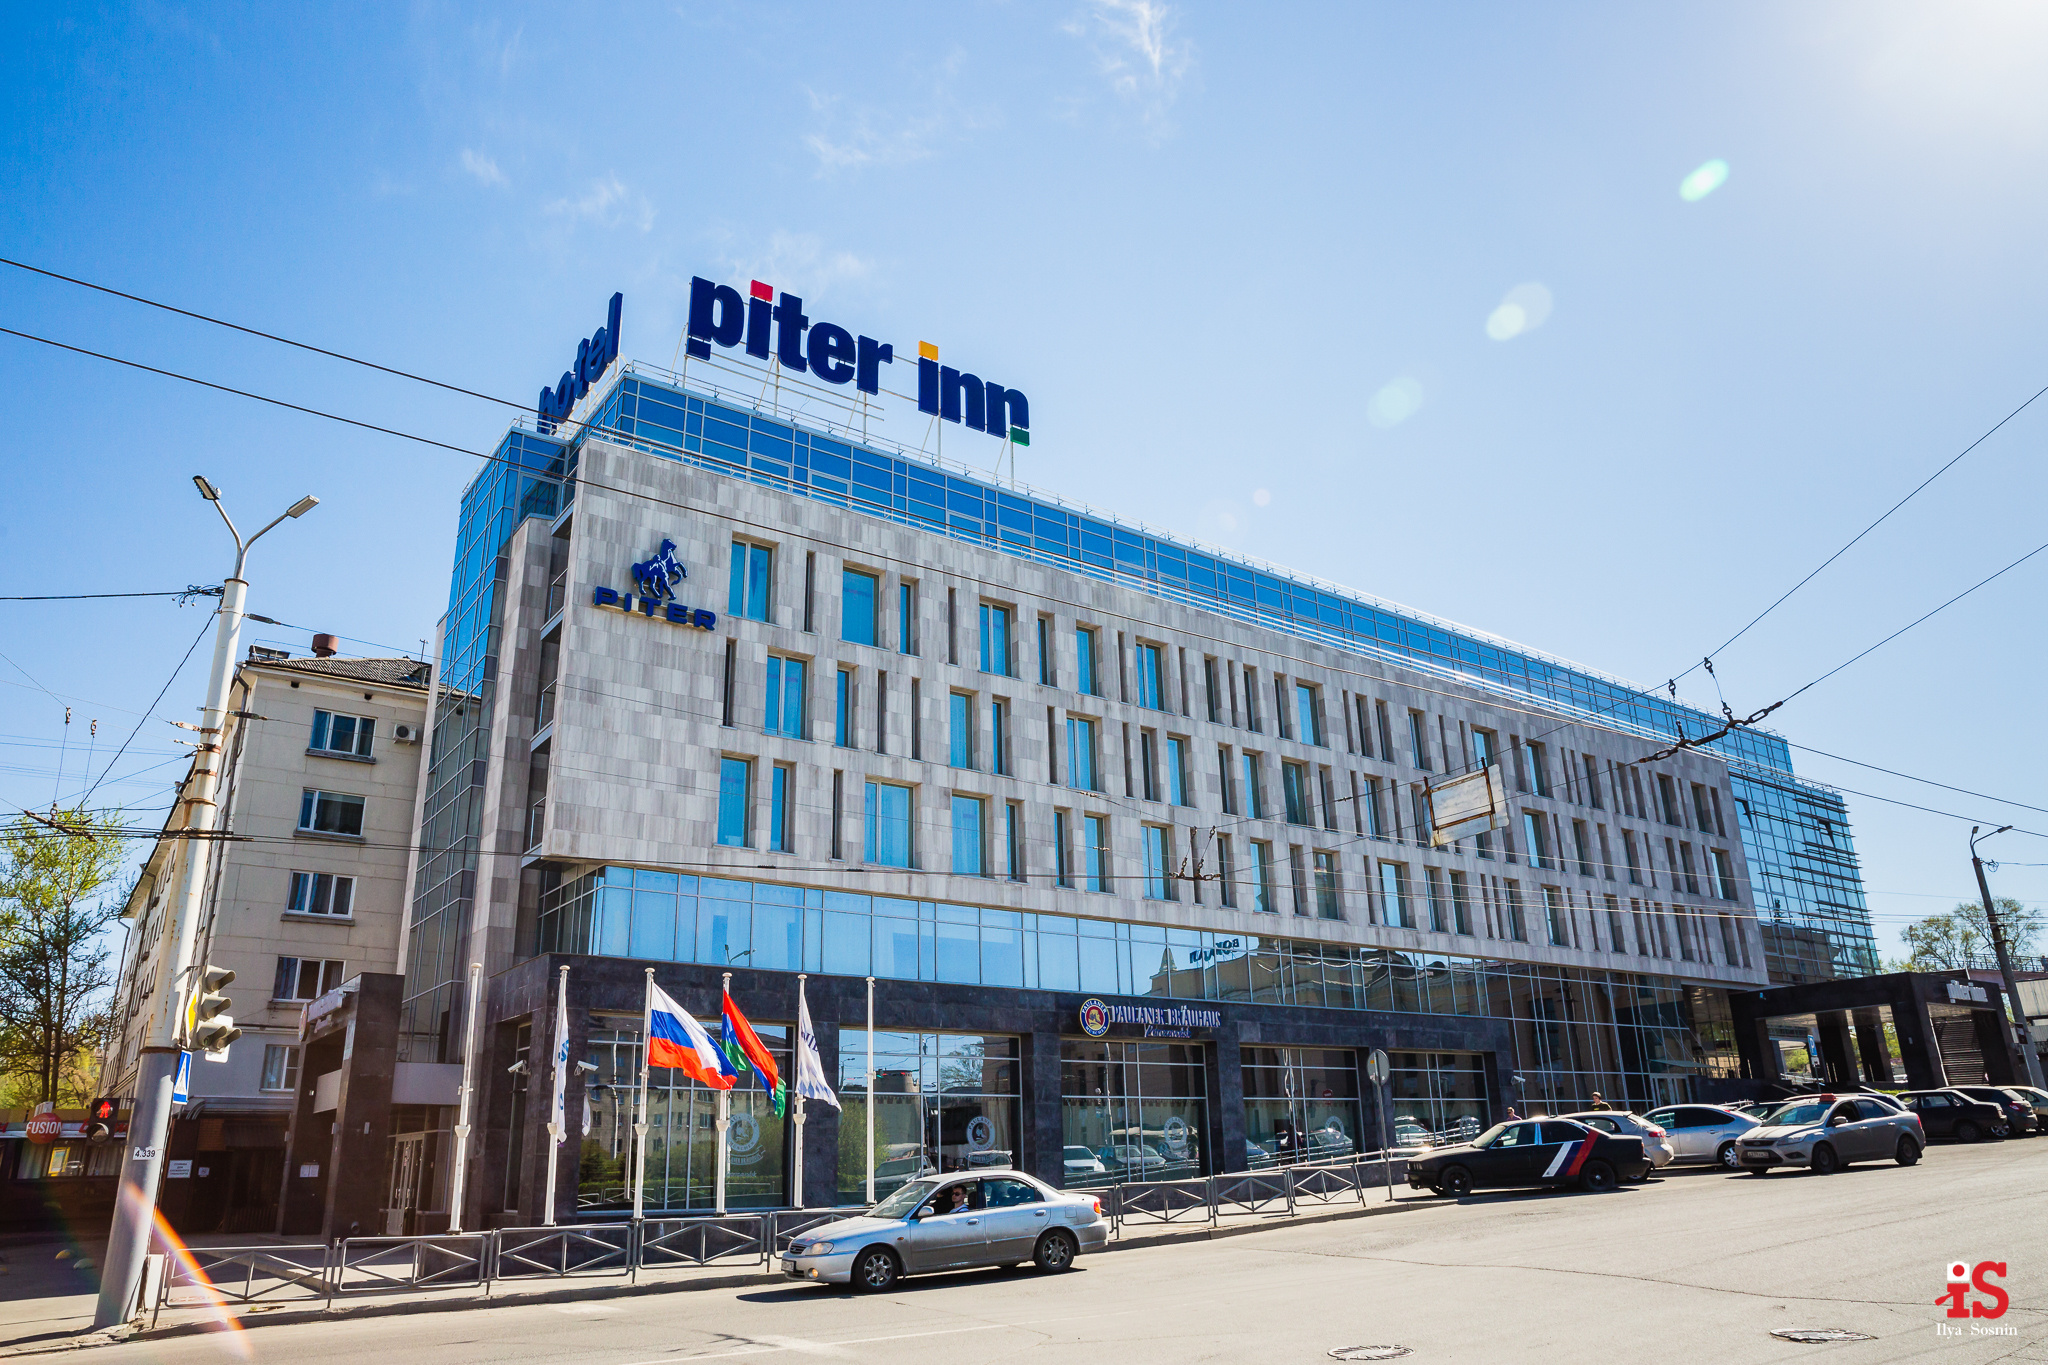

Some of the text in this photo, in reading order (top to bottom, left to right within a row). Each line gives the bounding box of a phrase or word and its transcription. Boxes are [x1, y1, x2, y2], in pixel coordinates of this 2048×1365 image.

[537, 291, 623, 436] hotel
[686, 276, 1030, 446] piter inn
[594, 586, 716, 631] PITER
[1081, 1000, 1107, 1014] PAULANER
[1110, 1005, 1221, 1028] PAULANER BRÄUHAUS
[26, 1121, 62, 1135] FUSION
[135, 1149, 156, 1158] 4.339
